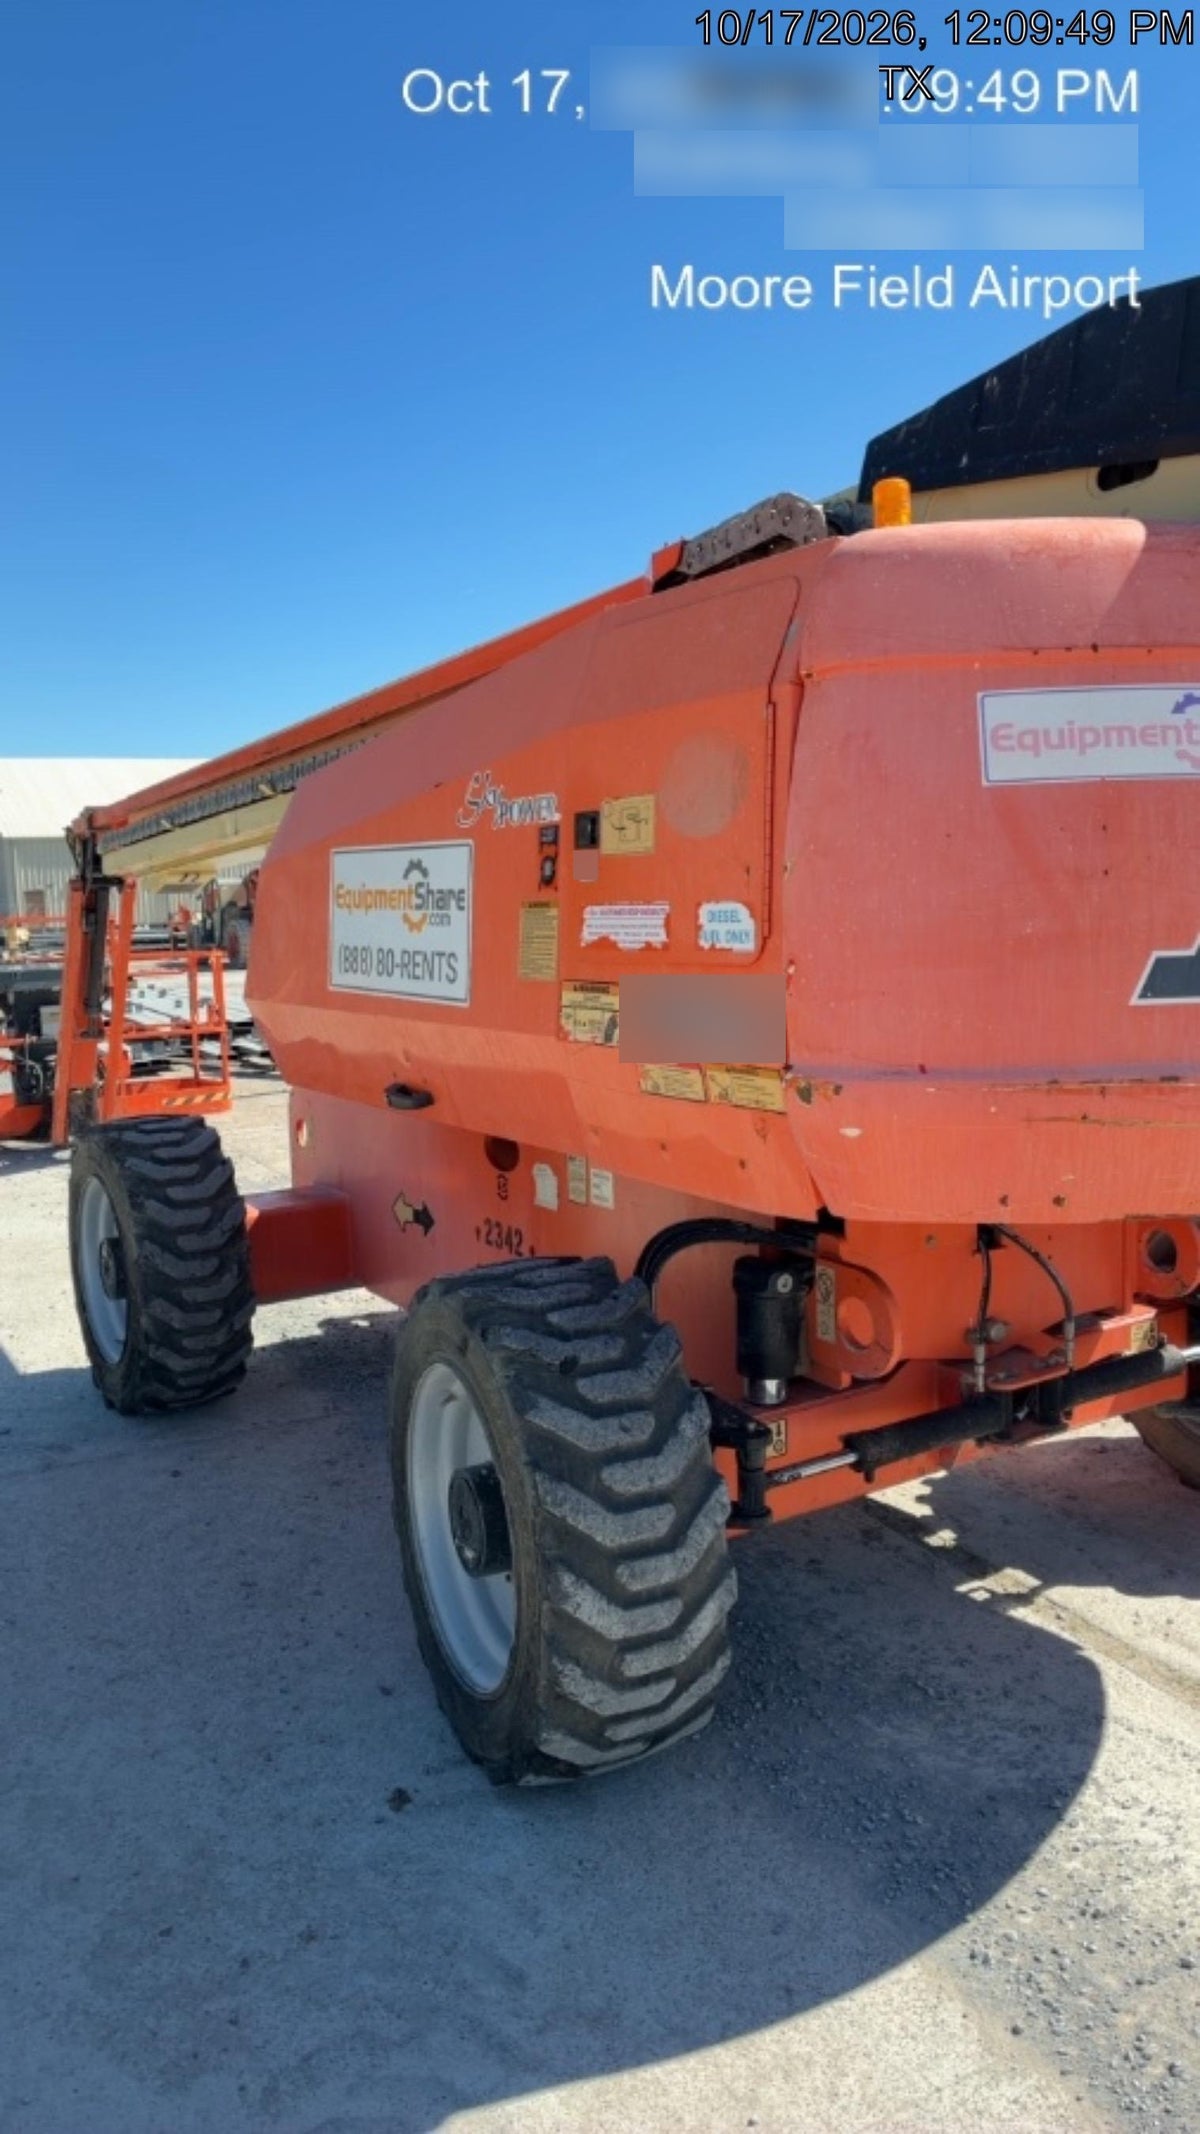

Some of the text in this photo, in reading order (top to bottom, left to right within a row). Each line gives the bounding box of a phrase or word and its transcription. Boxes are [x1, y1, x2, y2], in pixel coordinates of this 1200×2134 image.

[336, 881, 466, 916] EquipmentShare
[339, 943, 459, 985] (888) 80-RENTS
